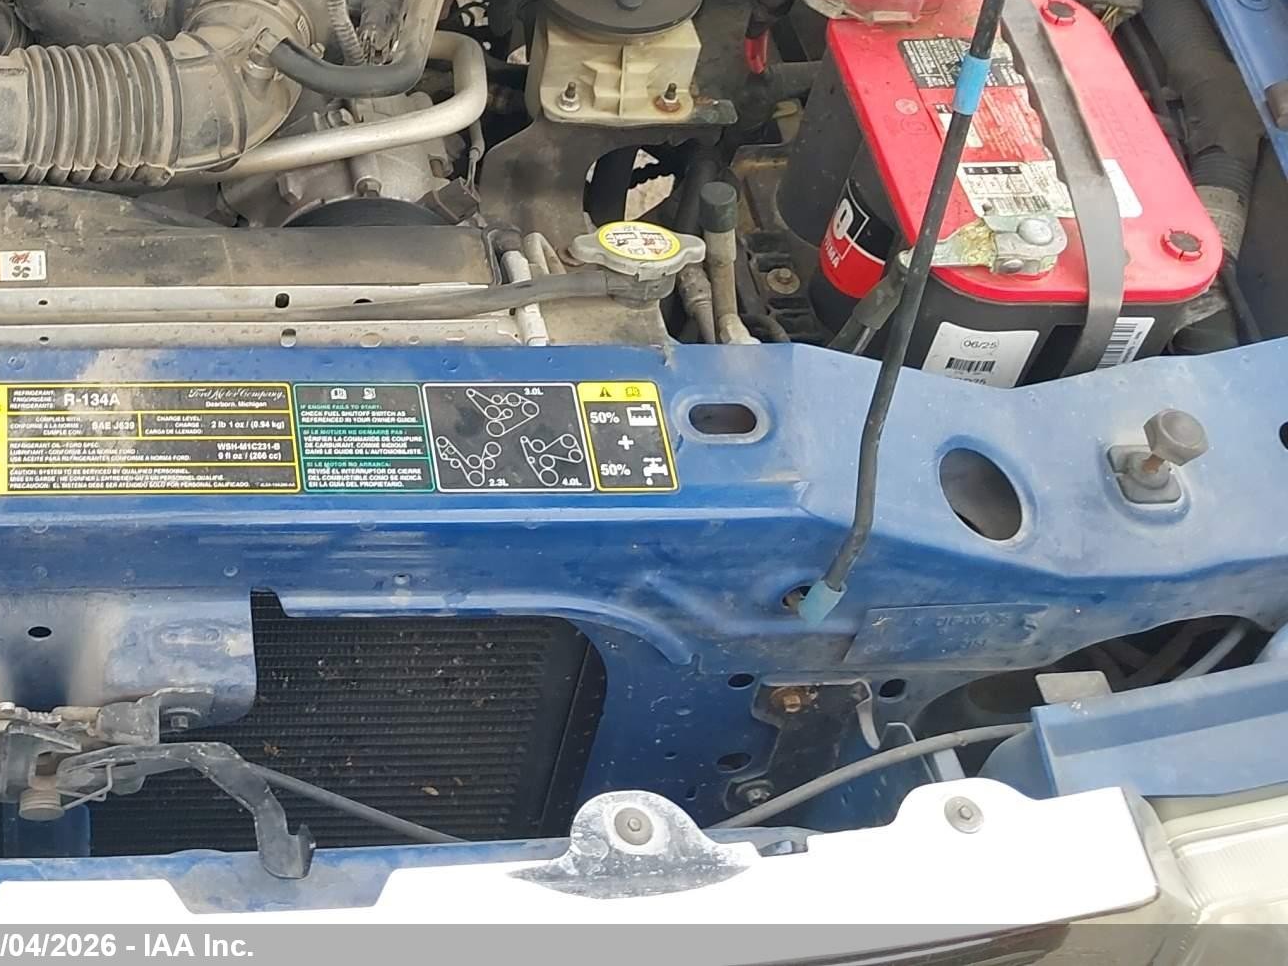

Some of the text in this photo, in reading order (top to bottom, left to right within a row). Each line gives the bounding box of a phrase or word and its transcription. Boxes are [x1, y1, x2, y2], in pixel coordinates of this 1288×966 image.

[963, 339, 998, 350] 06/25
[64, 393, 120, 406] R-134A
[188, 388, 211, 398] Ford
[211, 388, 238, 400] Motor
[590, 412, 620, 424] 50%
[92, 421, 111, 430] SAE
[233, 452, 242, 460] oz
[269, 452, 281, 460] cc)
[600, 464, 631, 476] 50%
